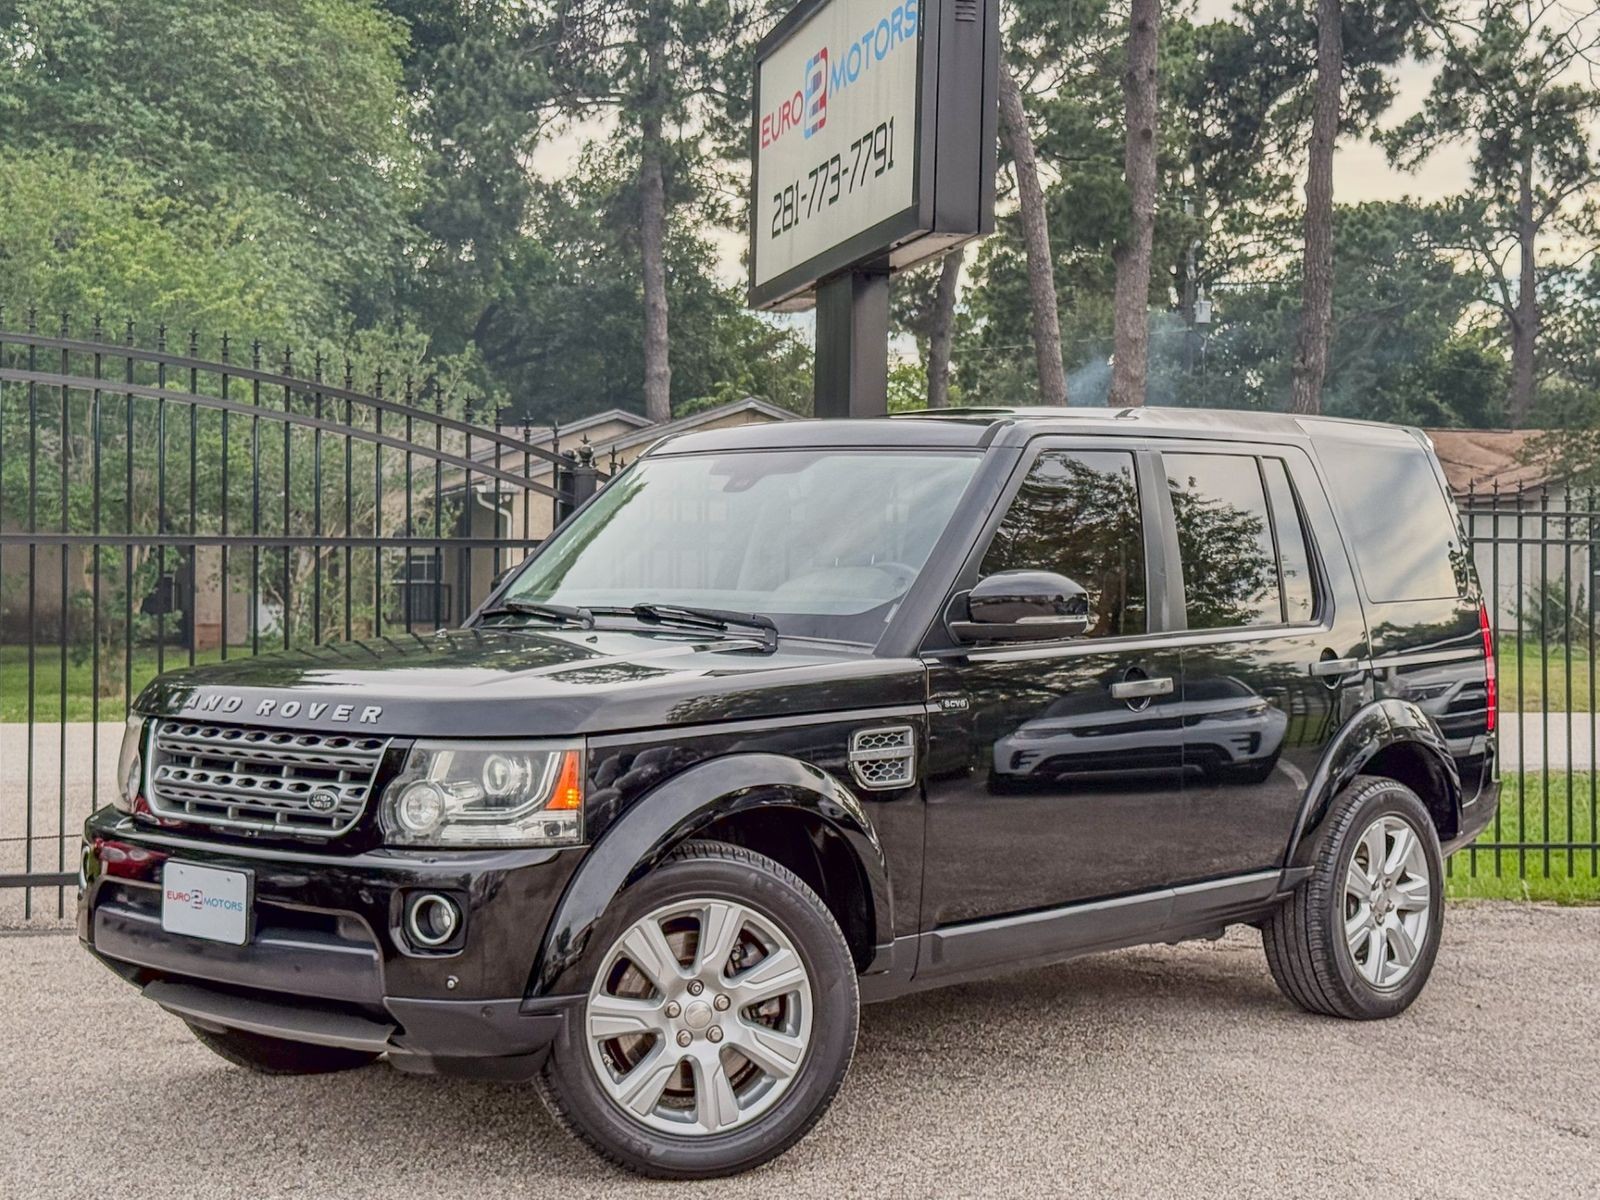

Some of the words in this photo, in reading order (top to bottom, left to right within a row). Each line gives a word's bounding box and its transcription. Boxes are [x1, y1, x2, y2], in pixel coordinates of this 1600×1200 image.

[762, 91, 803, 148] EURO
[829, 0, 917, 98] MOTORS
[772, 116, 894, 239] 281-773-7791
[168, 692, 243, 713] LAND
[256, 699, 382, 723] ROVER
[167, 891, 190, 902] EURO
[204, 897, 243, 912] MOTORS
